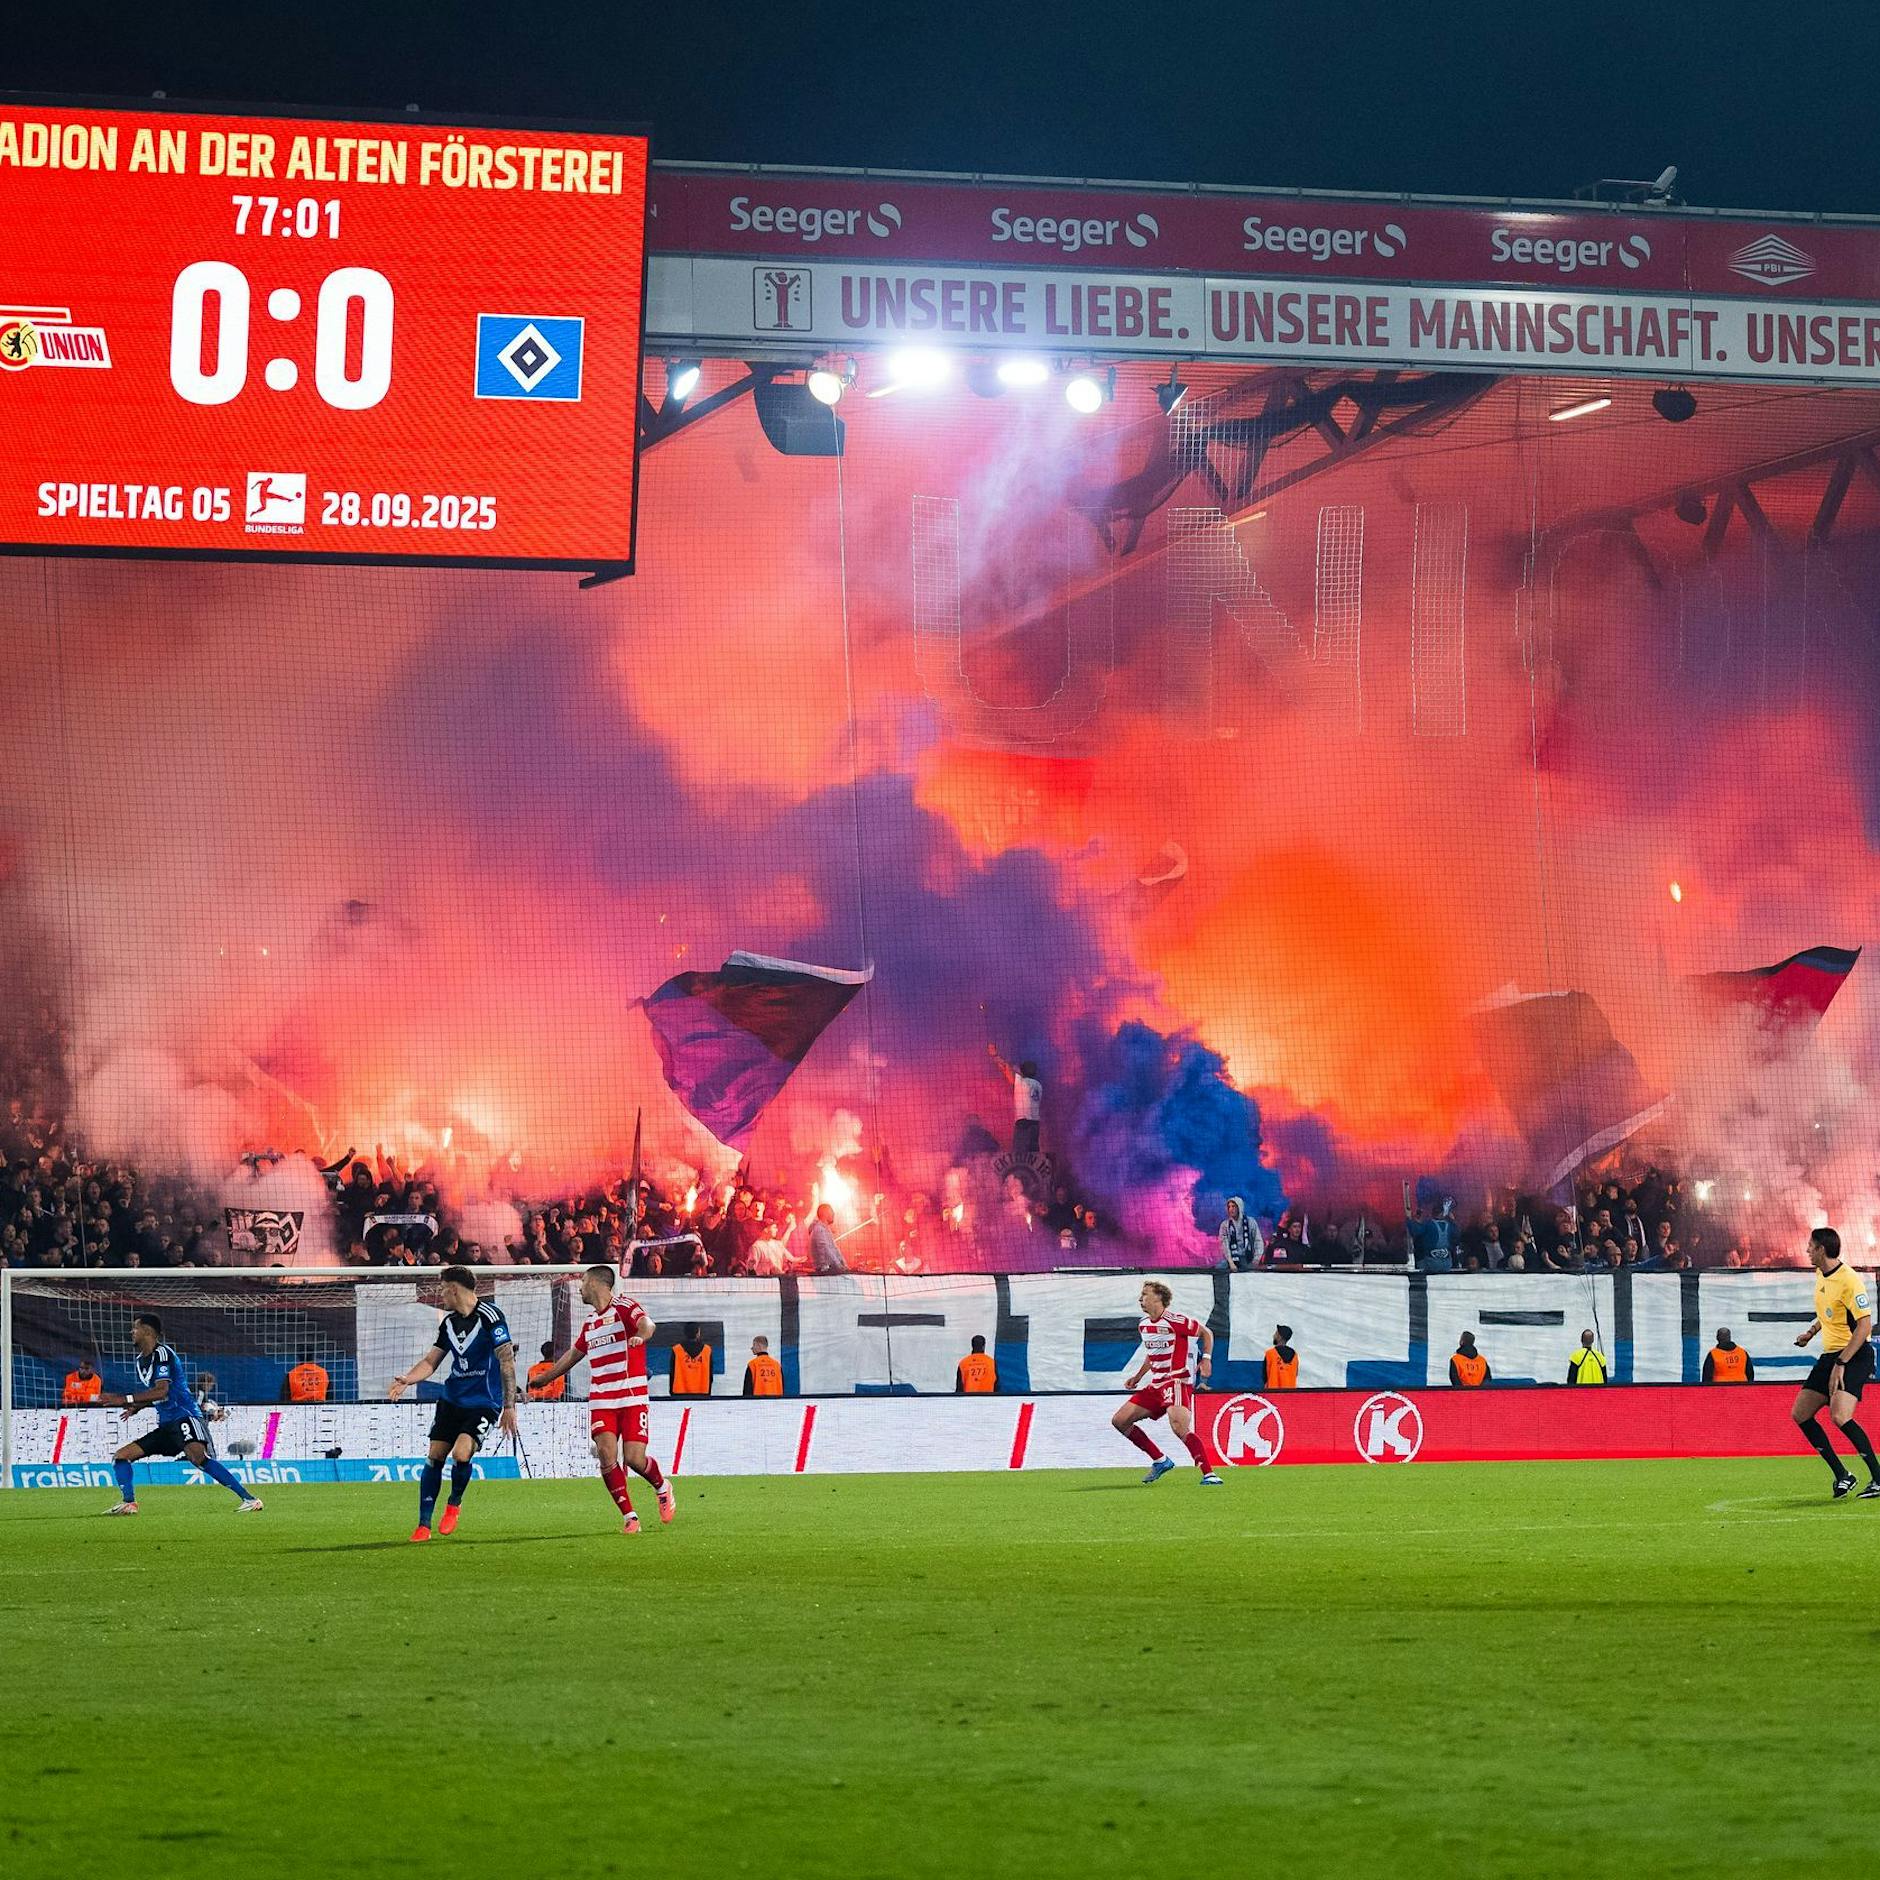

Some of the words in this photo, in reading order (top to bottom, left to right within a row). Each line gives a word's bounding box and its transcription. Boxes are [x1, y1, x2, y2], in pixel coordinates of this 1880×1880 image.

[0, 121, 118, 171] ADION
[129, 128, 187, 175] AN
[200, 131, 275, 178] DER
[286, 135, 408, 185] ALTEN
[420, 134, 624, 195] FÖRSTEREI
[232, 195, 341, 239] 77:01
[730, 196, 861, 242] Seeger
[991, 208, 1120, 252] Seeger
[1243, 216, 1369, 262] Seeger
[1491, 229, 1614, 273] Seeger
[1764, 263, 1781, 273] PBI
[170, 260, 396, 411] 0:0
[841, 275, 1027, 335] UNSERE
[1045, 283, 1190, 340] LIEBE.
[1211, 290, 1390, 348] UNSERE
[1409, 296, 1728, 362] MANNSCHAFT.
[39, 332, 105, 361] UNION
[37, 482, 184, 521] SPIELTAG
[191, 487, 231, 522] 05
[321, 491, 498, 530] 28.09.2025
[245, 524, 305, 534] BUNDESLIGA
[180, 1422, 191, 1435] 9
[639, 1411, 648, 1429] 8
[20, 1465, 113, 1489] raisin
[215, 1463, 301, 1485] aisin
